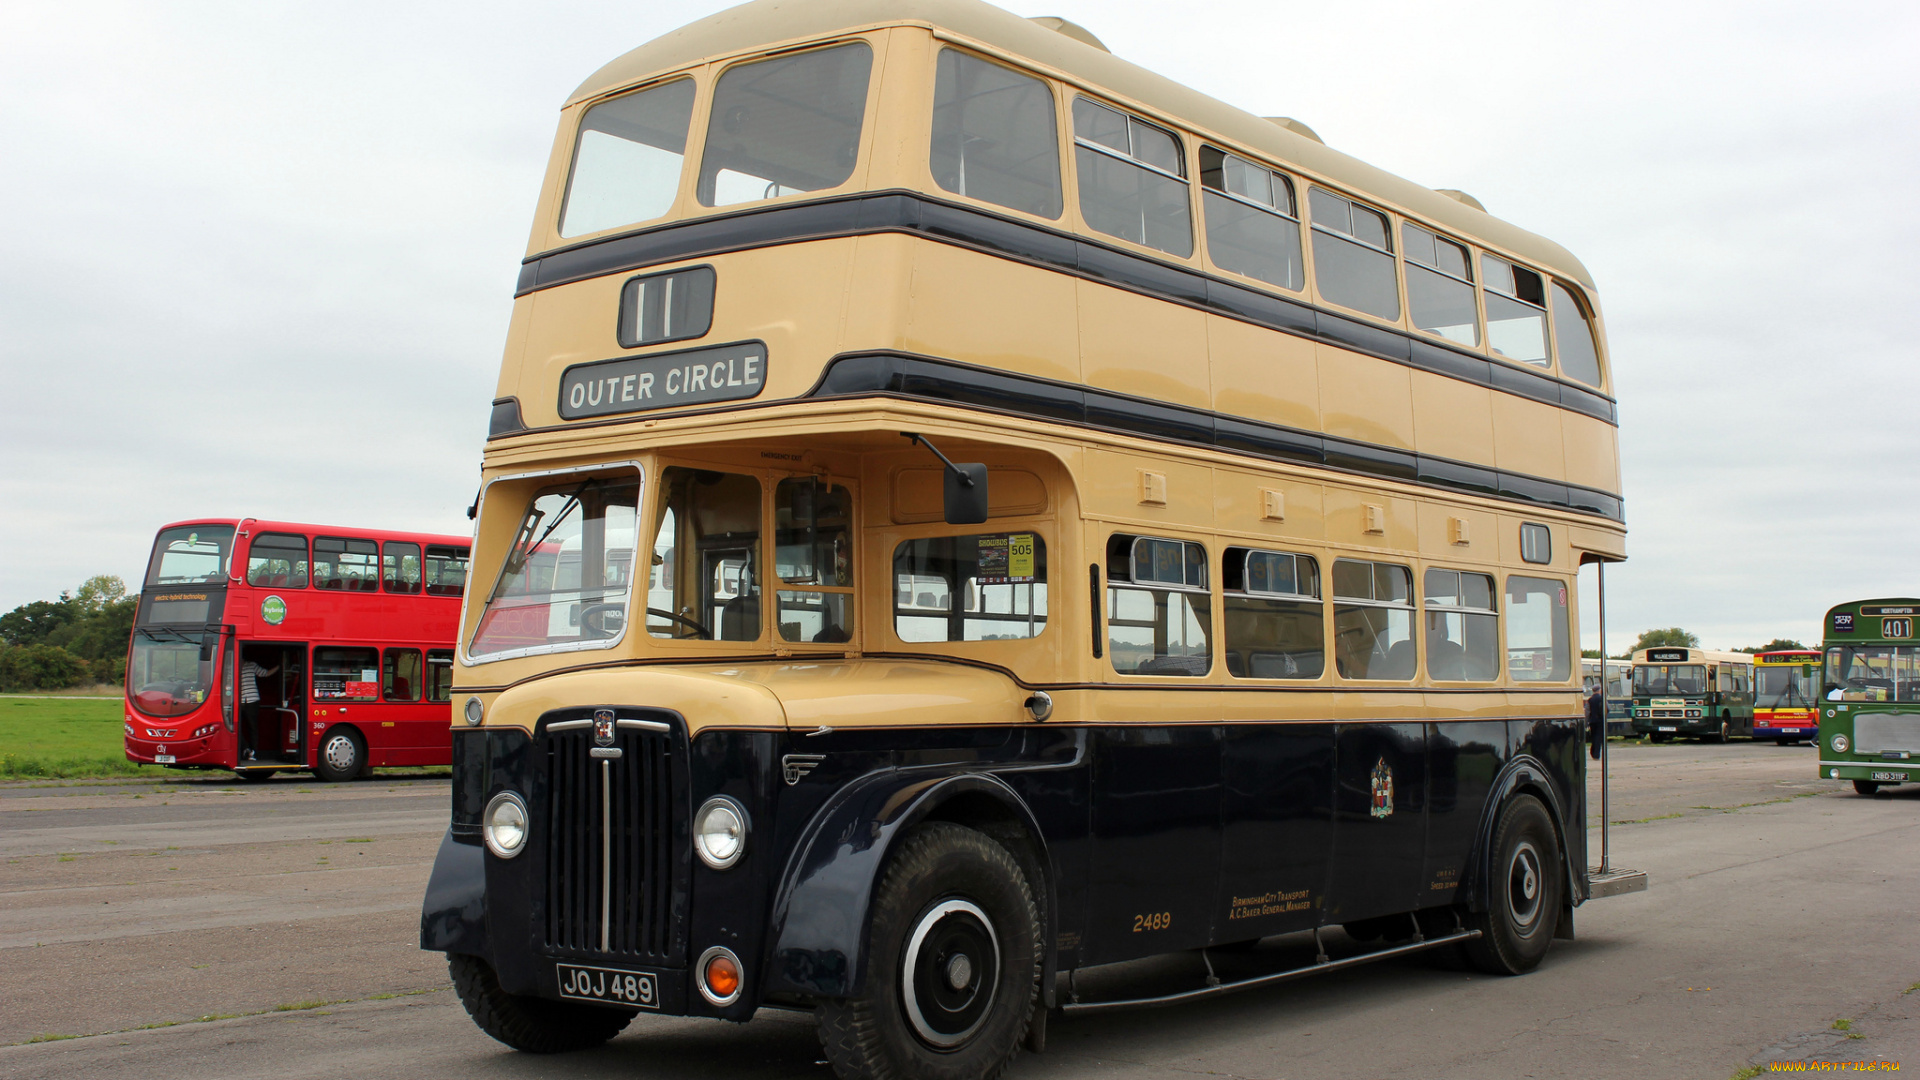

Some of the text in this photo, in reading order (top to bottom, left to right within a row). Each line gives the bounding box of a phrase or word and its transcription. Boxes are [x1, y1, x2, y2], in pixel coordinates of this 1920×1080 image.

[636, 277, 674, 342] 11
[569, 355, 760, 409] OUTER CIRCLE
[760, 451, 803, 462] EMERGENCY EXIT
[979, 539, 1007, 547] SHOWBUS
[1011, 544, 1032, 556] 505
[1884, 620, 1910, 637] 401
[1232, 889, 1310, 907] BIRMINGHAM CITY TRANSPORT
[1262, 904, 1286, 915] GENERAL
[1285, 901, 1311, 911] MANAGER
[1132, 911, 1171, 932] 2489
[563, 969, 653, 1003] JOJ 489
